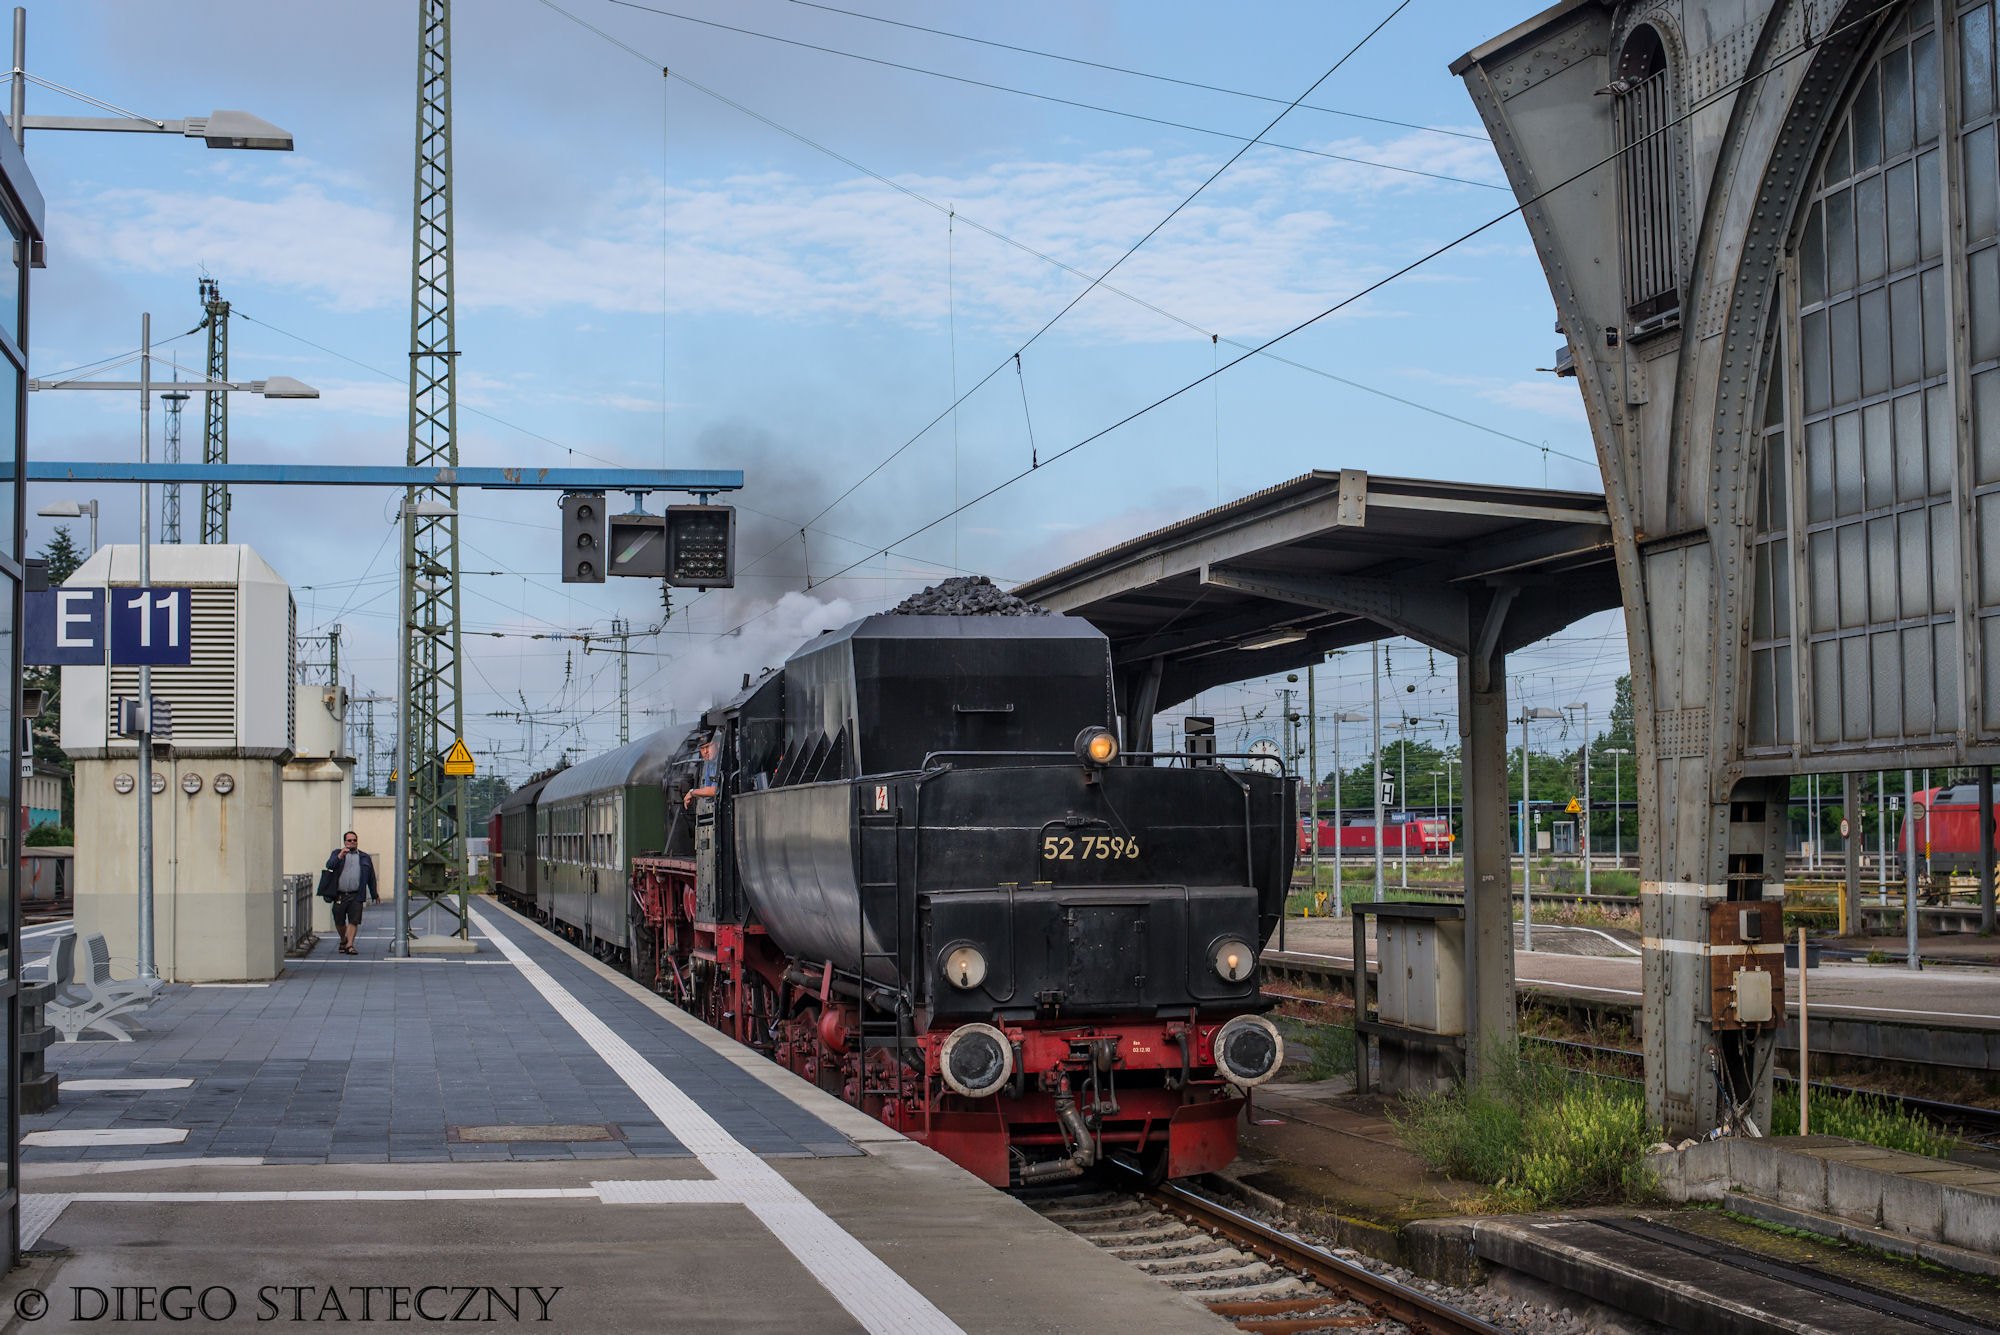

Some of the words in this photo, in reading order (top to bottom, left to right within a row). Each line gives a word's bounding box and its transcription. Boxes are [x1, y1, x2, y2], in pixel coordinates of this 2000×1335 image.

[57, 591, 93, 647] E
[128, 591, 179, 647] 11
[1382, 784, 1393, 802] H
[1891, 798, 1898, 809] H
[1044, 836, 1074, 860] 52
[1081, 836, 1139, 860] 7596
